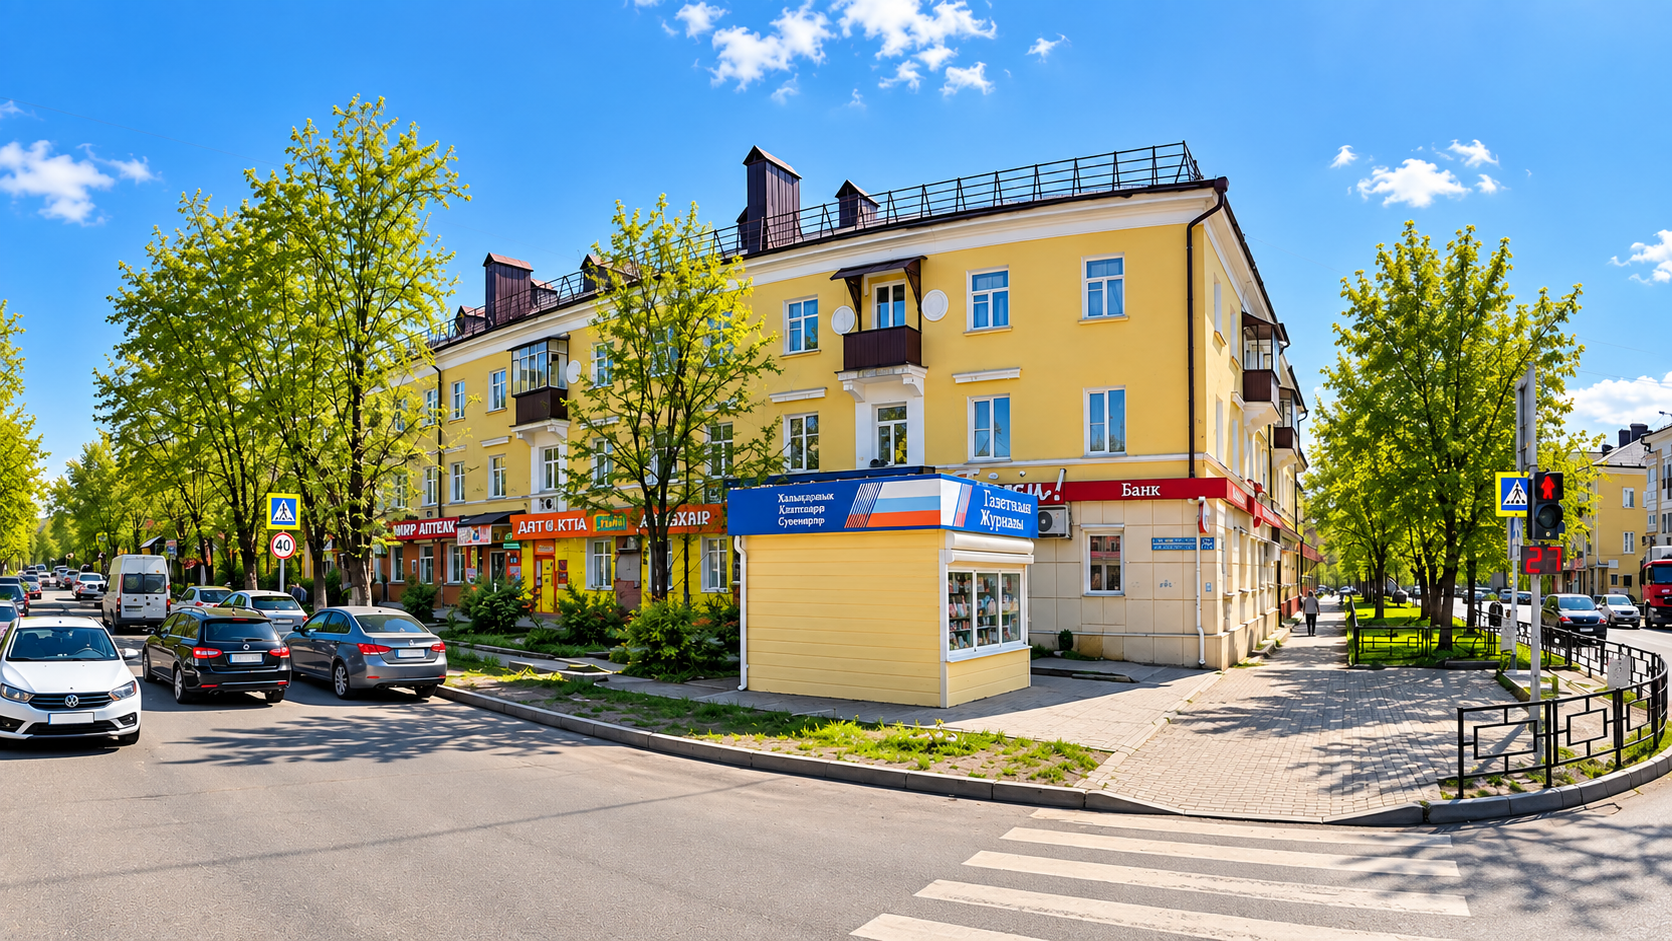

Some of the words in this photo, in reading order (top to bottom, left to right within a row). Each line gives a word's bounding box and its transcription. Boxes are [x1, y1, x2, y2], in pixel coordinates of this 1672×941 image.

[1121, 482, 1161, 497] Банк
[275, 538, 291, 552] 40
[1525, 546, 1562, 574] 27
